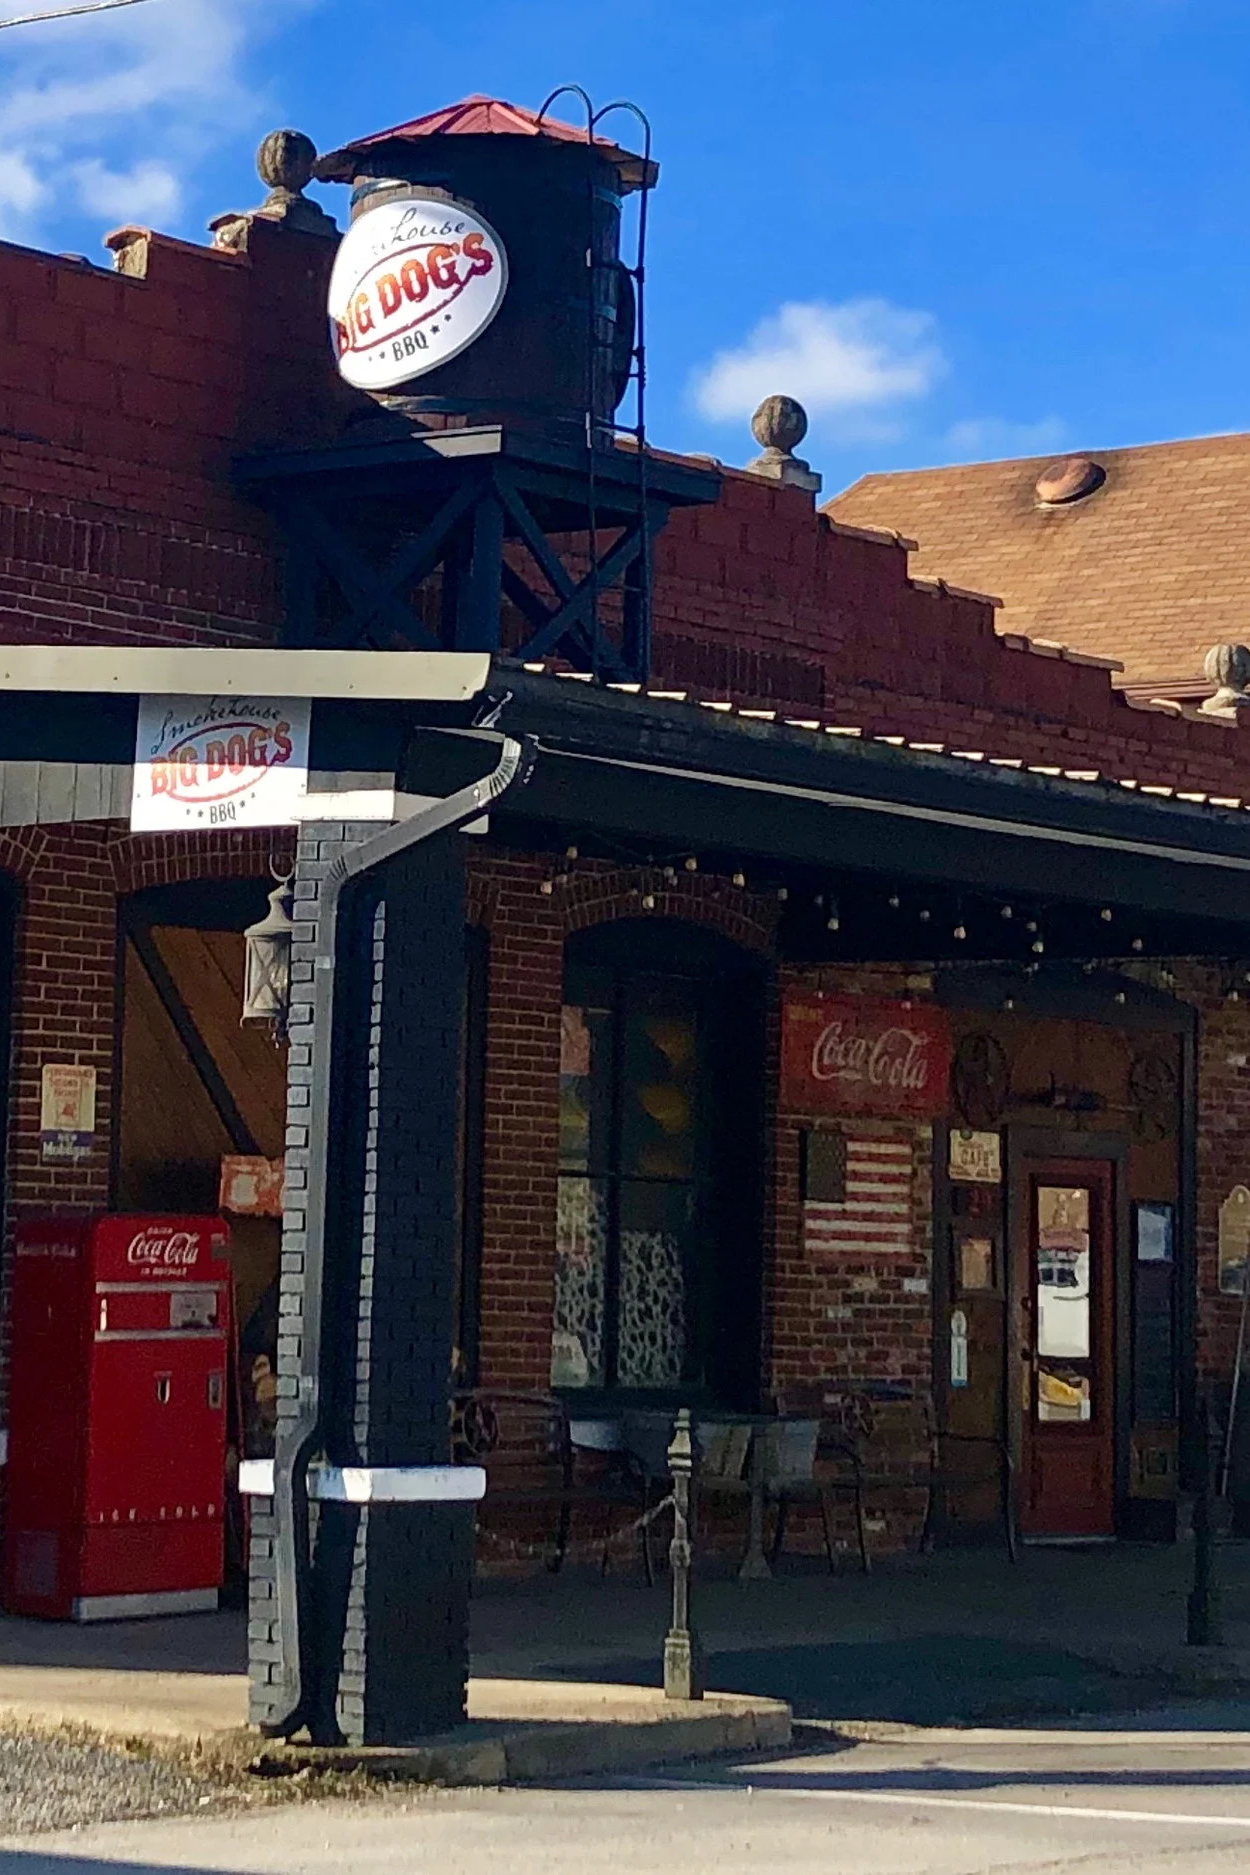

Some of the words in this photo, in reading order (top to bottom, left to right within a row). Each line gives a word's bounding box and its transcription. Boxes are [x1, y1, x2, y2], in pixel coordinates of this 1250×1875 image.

[375, 232, 493, 319] DOG'S
[392, 329, 429, 362] BBQ
[150, 694, 280, 755] Smokehouse
[151, 746, 199, 796] BIG
[206, 721, 292, 782] DOG'S
[210, 801, 236, 824] BBQ
[812, 1022, 929, 1089] Coca-Cola
[127, 1230, 200, 1265] Coca-Cola
